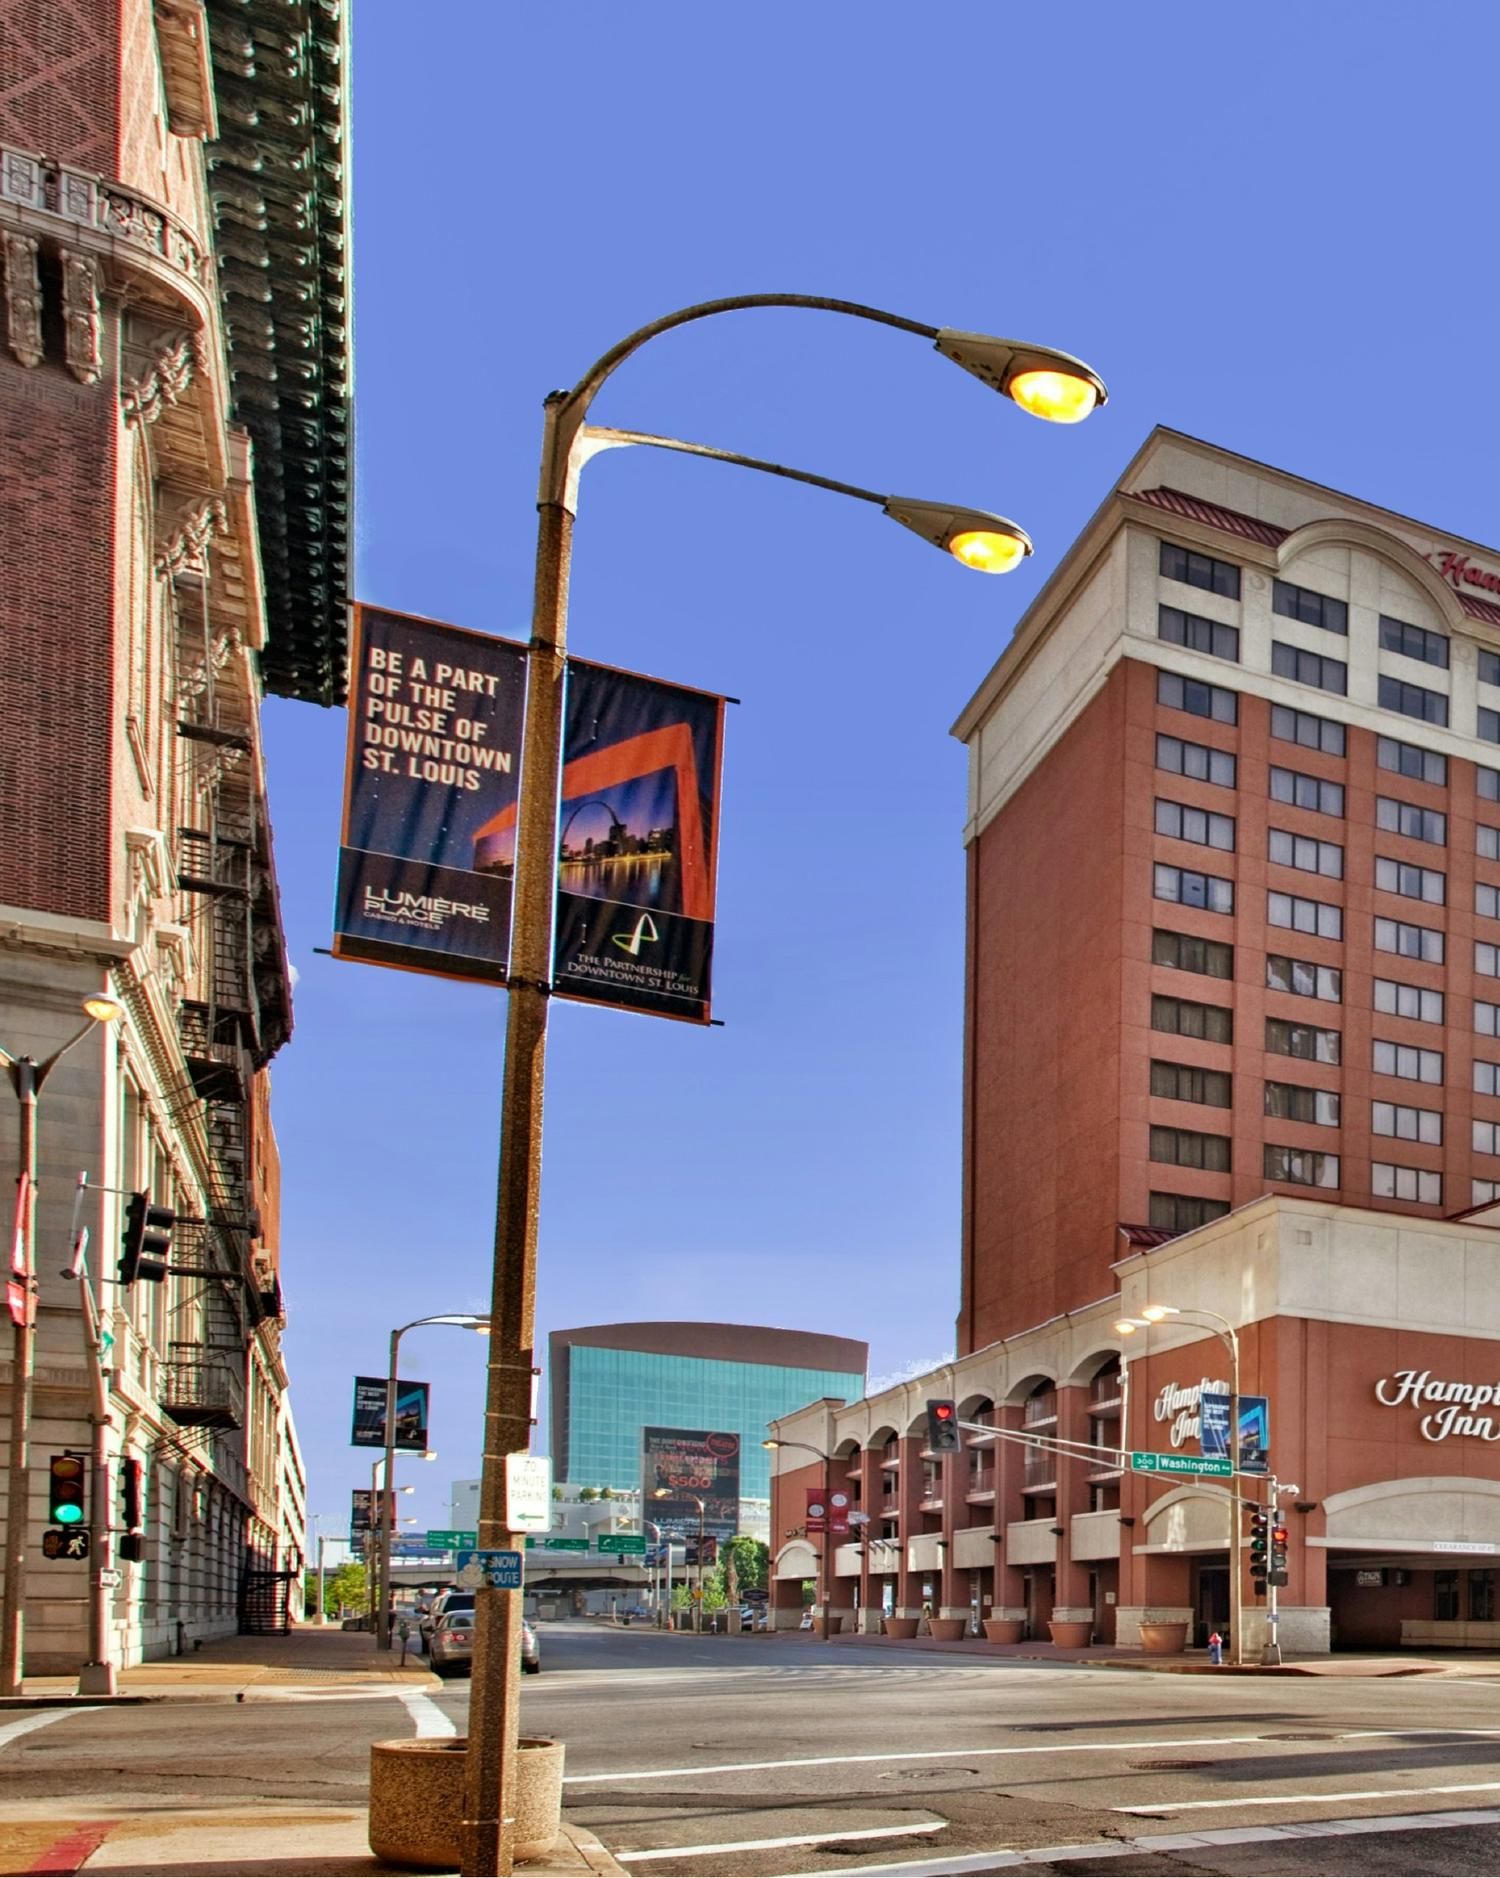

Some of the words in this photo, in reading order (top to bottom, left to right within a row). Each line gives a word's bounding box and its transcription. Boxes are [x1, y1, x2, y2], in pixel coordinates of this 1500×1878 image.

[370, 647, 402, 674] BE
[410, 658, 427, 680] A
[436, 663, 499, 696] PART
[369, 673, 401, 698] OF
[409, 682, 456, 712] THE
[367, 697, 447, 734] PULSE
[456, 718, 487, 741] OF
[366, 722, 511, 773] DOWNTOWN
[363, 748, 399, 774] ST.
[409, 757, 480, 790] LOUIS
[364, 899, 444, 925] PLACE
[567, 962, 645, 984] DOWNTOWN
[665, 981, 699, 994] LOUIS
[577, 953, 600, 966] THE
[603, 957, 678, 980] PARTNERSHIP
[1160, 1458, 1221, 1473] Washington
[512, 1474, 545, 1488] MINUTE
[668, 1474, 712, 1489] $500
[488, 1555, 519, 1569] SNOW
